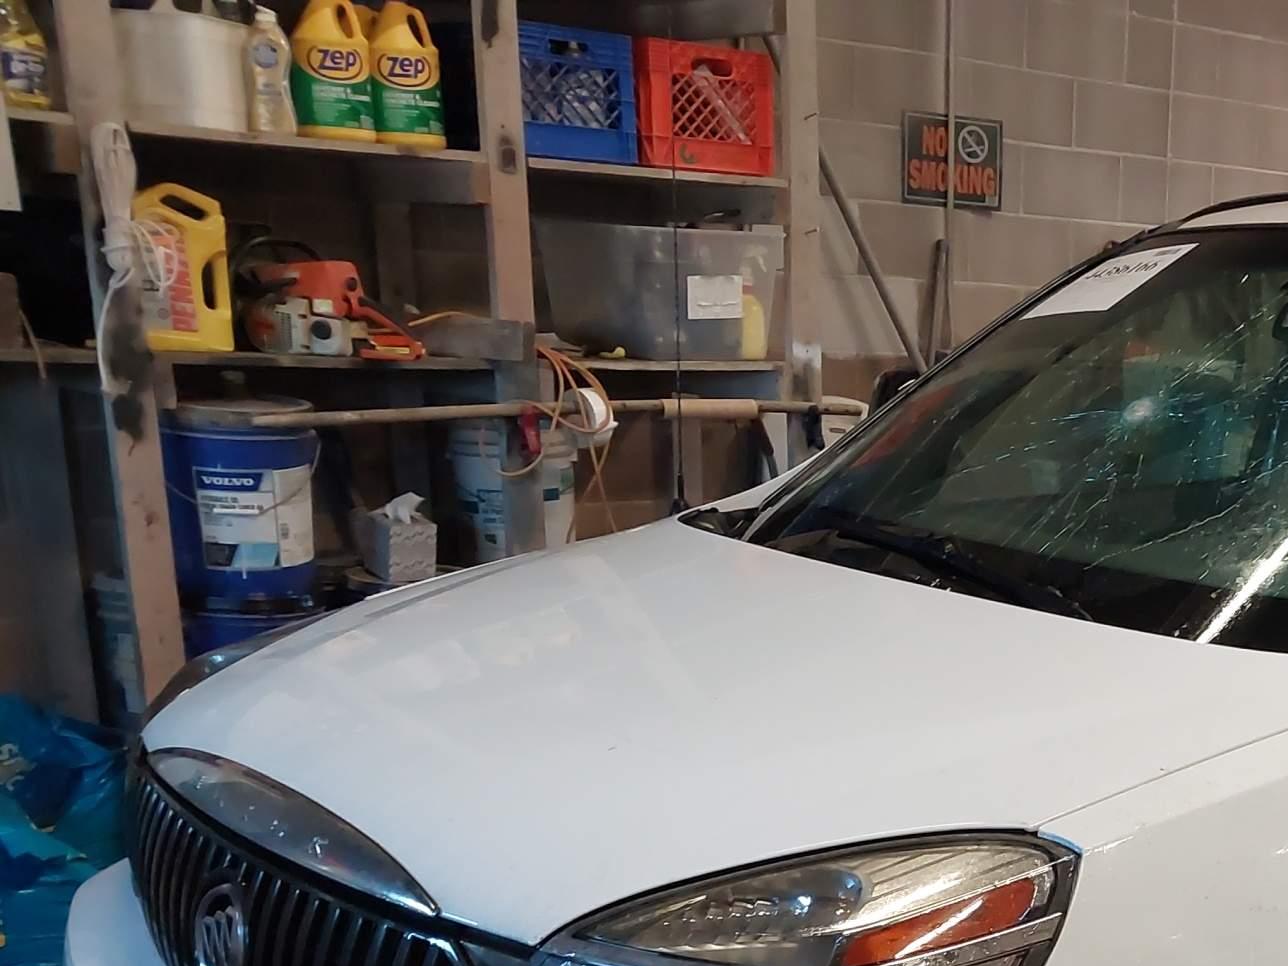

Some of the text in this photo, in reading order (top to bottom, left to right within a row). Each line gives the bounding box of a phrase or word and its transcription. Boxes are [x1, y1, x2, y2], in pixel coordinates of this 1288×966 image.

[922, 125, 948, 157] NO
[909, 158, 996, 196] SMOKING
[200, 475, 255, 487] VOLVO
